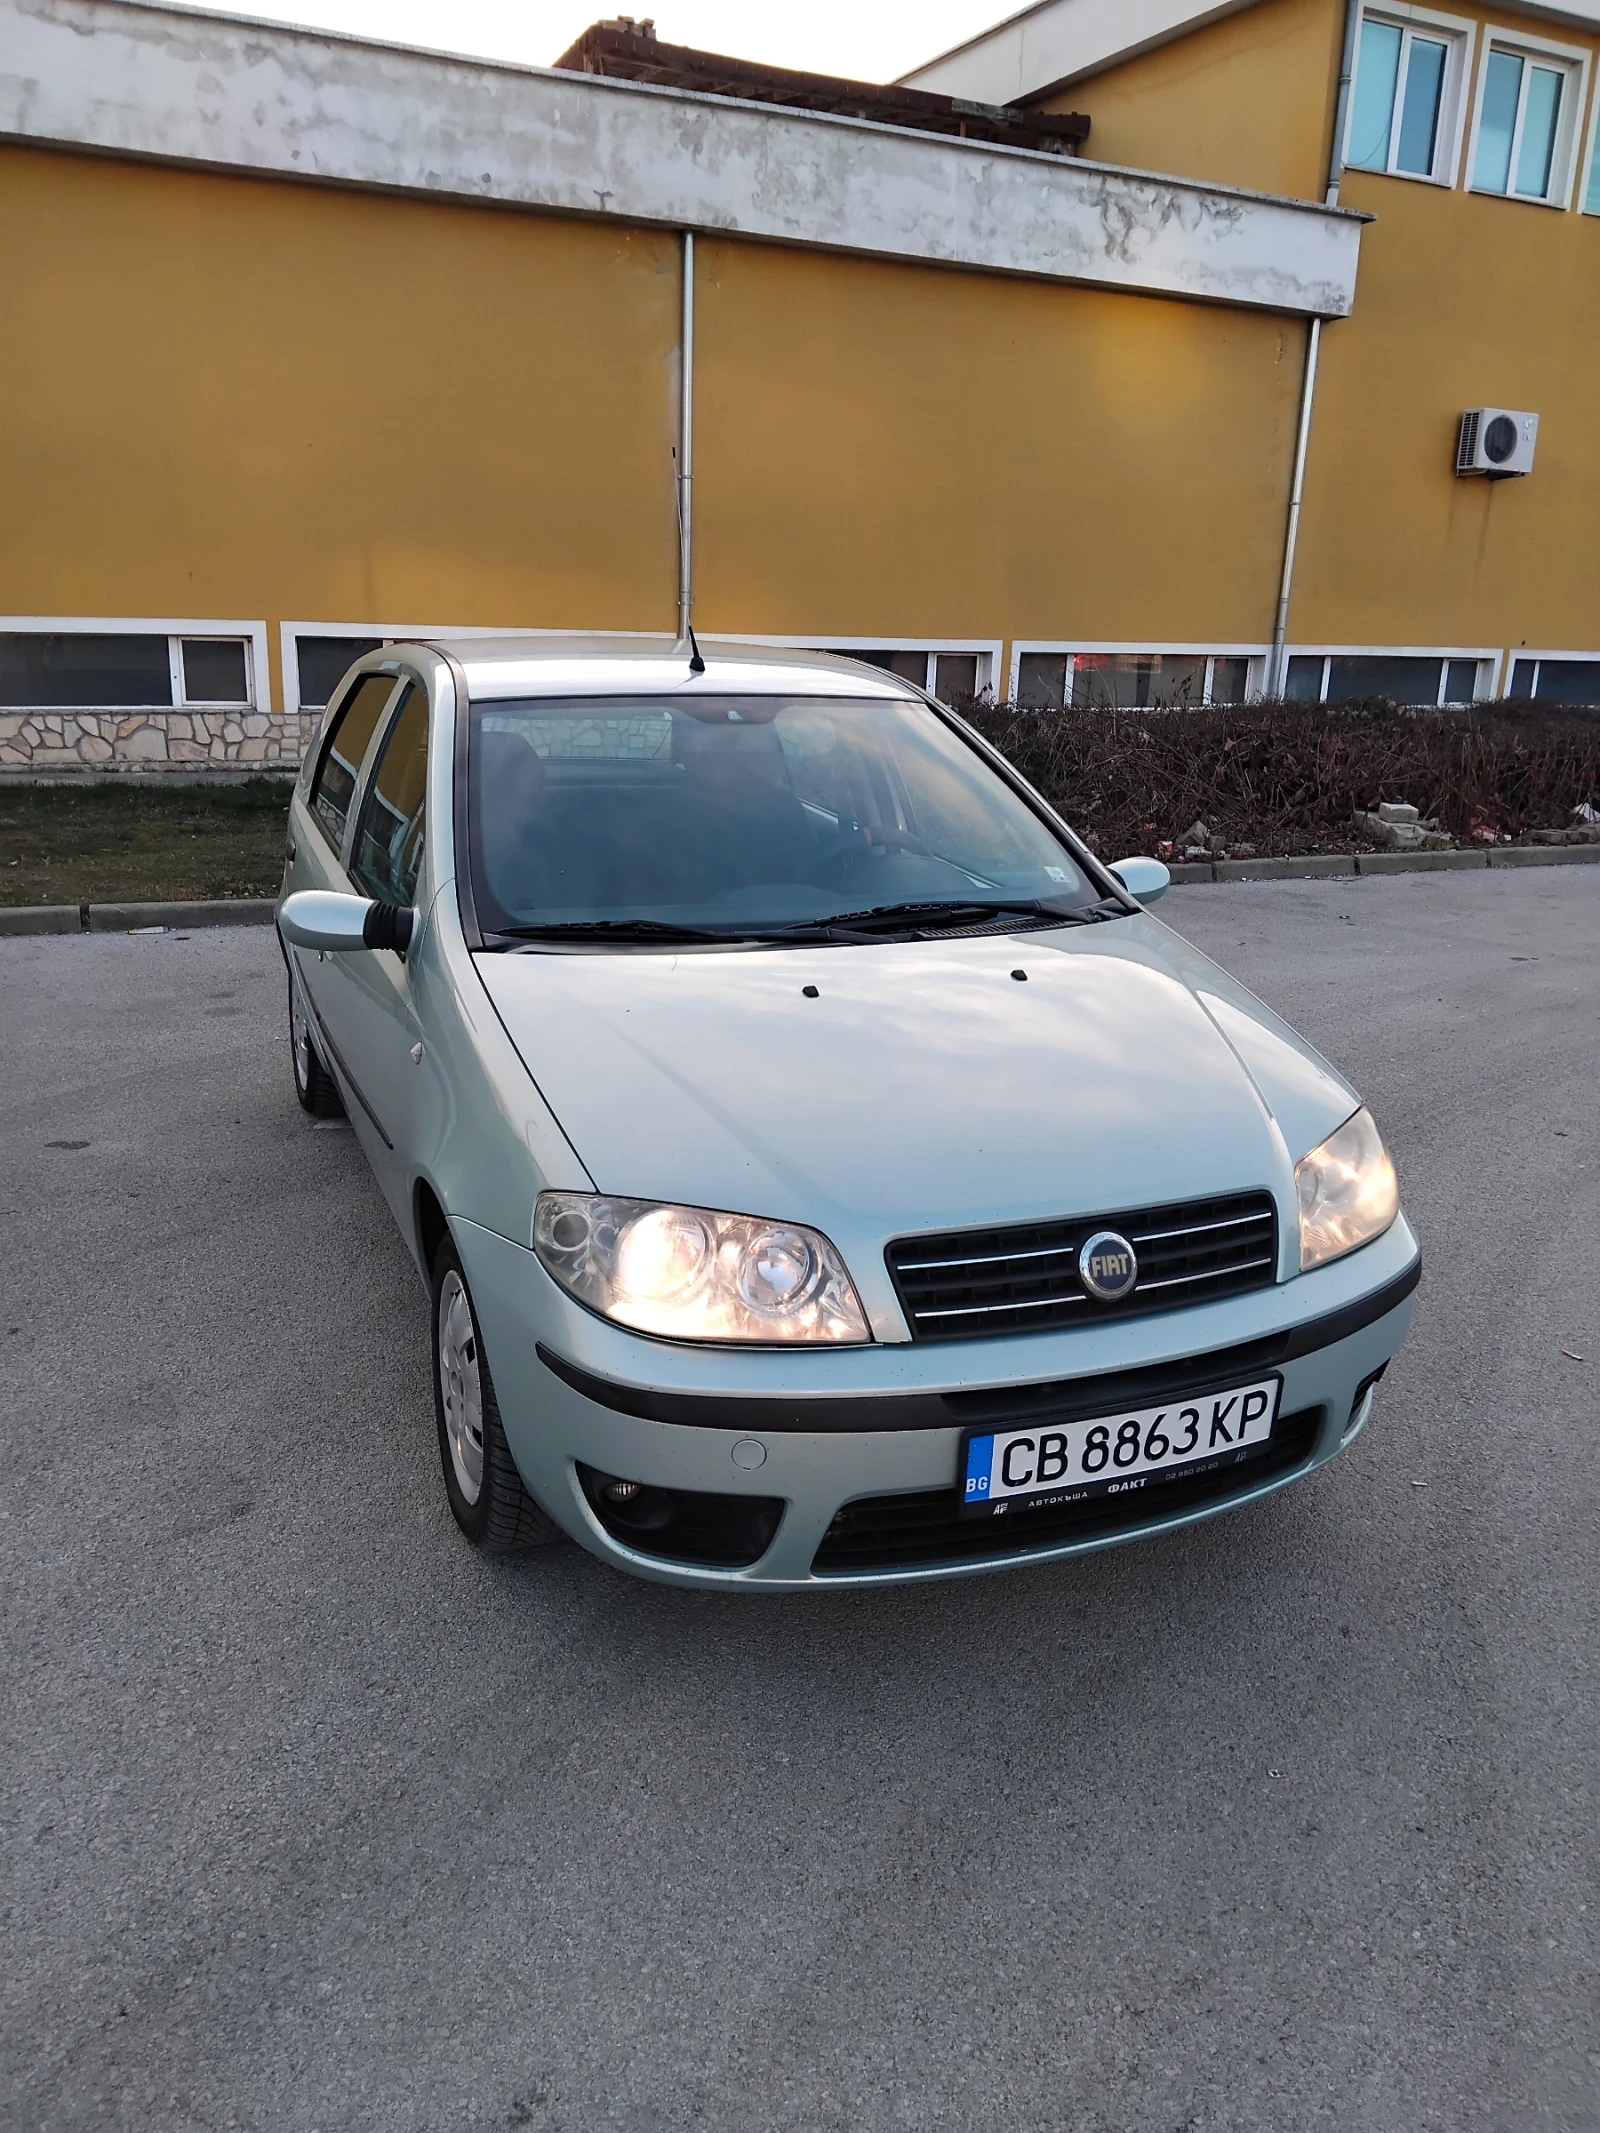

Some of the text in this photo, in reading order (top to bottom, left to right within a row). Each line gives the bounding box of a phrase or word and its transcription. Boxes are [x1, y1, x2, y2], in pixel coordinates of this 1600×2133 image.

[1091, 1253, 1128, 1278] FIAT
[1001, 1389, 1269, 1488] CB 8863 KP
[966, 1476, 988, 1493] BG
[1028, 1478, 1147, 1508] АВТОКЪША ФАКТ
